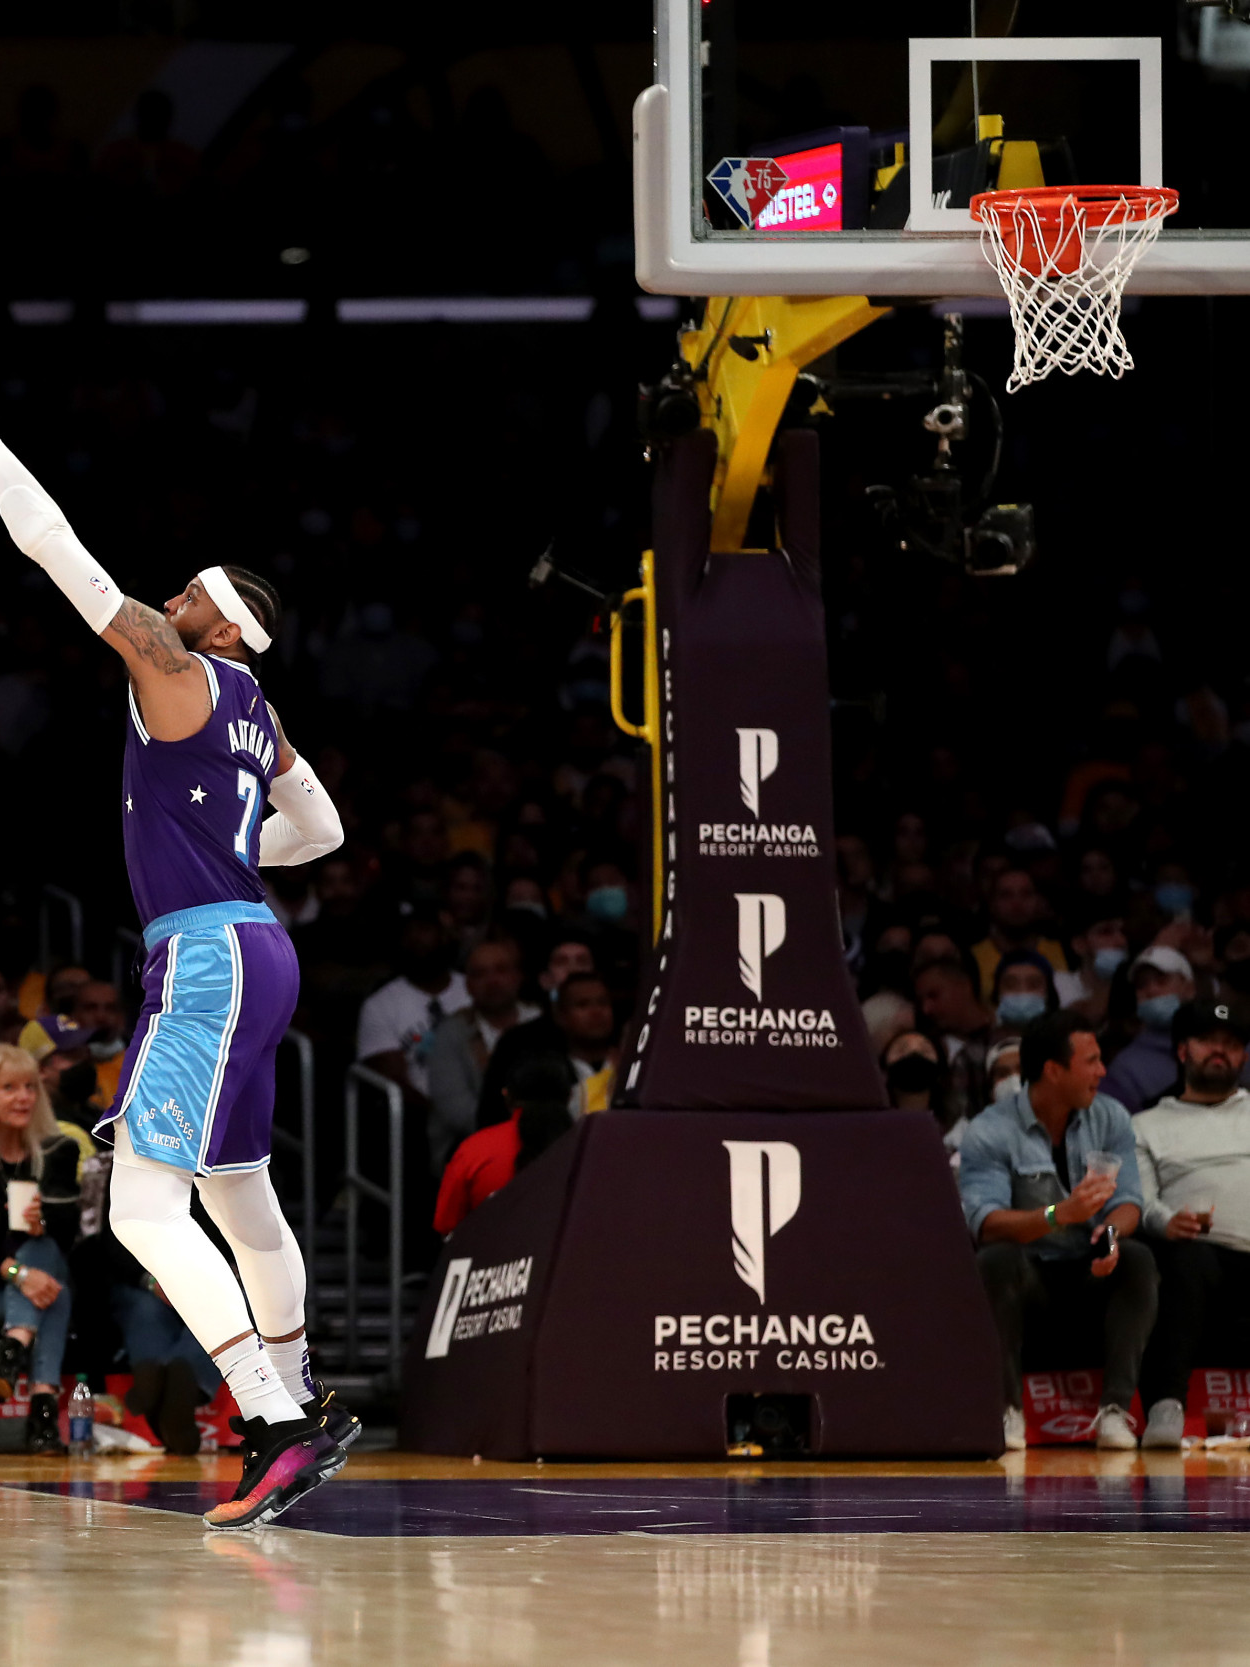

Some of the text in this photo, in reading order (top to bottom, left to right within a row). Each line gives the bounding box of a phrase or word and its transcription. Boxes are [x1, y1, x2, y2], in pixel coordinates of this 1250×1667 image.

[756, 168, 772, 189] 75
[233, 767, 262, 868] 7
[699, 823, 817, 843] PECHANGA
[699, 843, 819, 858] RESORT CASINO
[684, 1006, 836, 1032] PECHANGA
[684, 1029, 839, 1048] RESORT CASINO
[137, 1098, 194, 1141] LOS ANGELES
[147, 1130, 181, 1150] LAKERS
[461, 1256, 533, 1308] PECHANGA
[654, 1314, 875, 1346] PECHANGA
[654, 1350, 879, 1371] RESORT CASINO
[1205, 1371, 1250, 1395] BI
